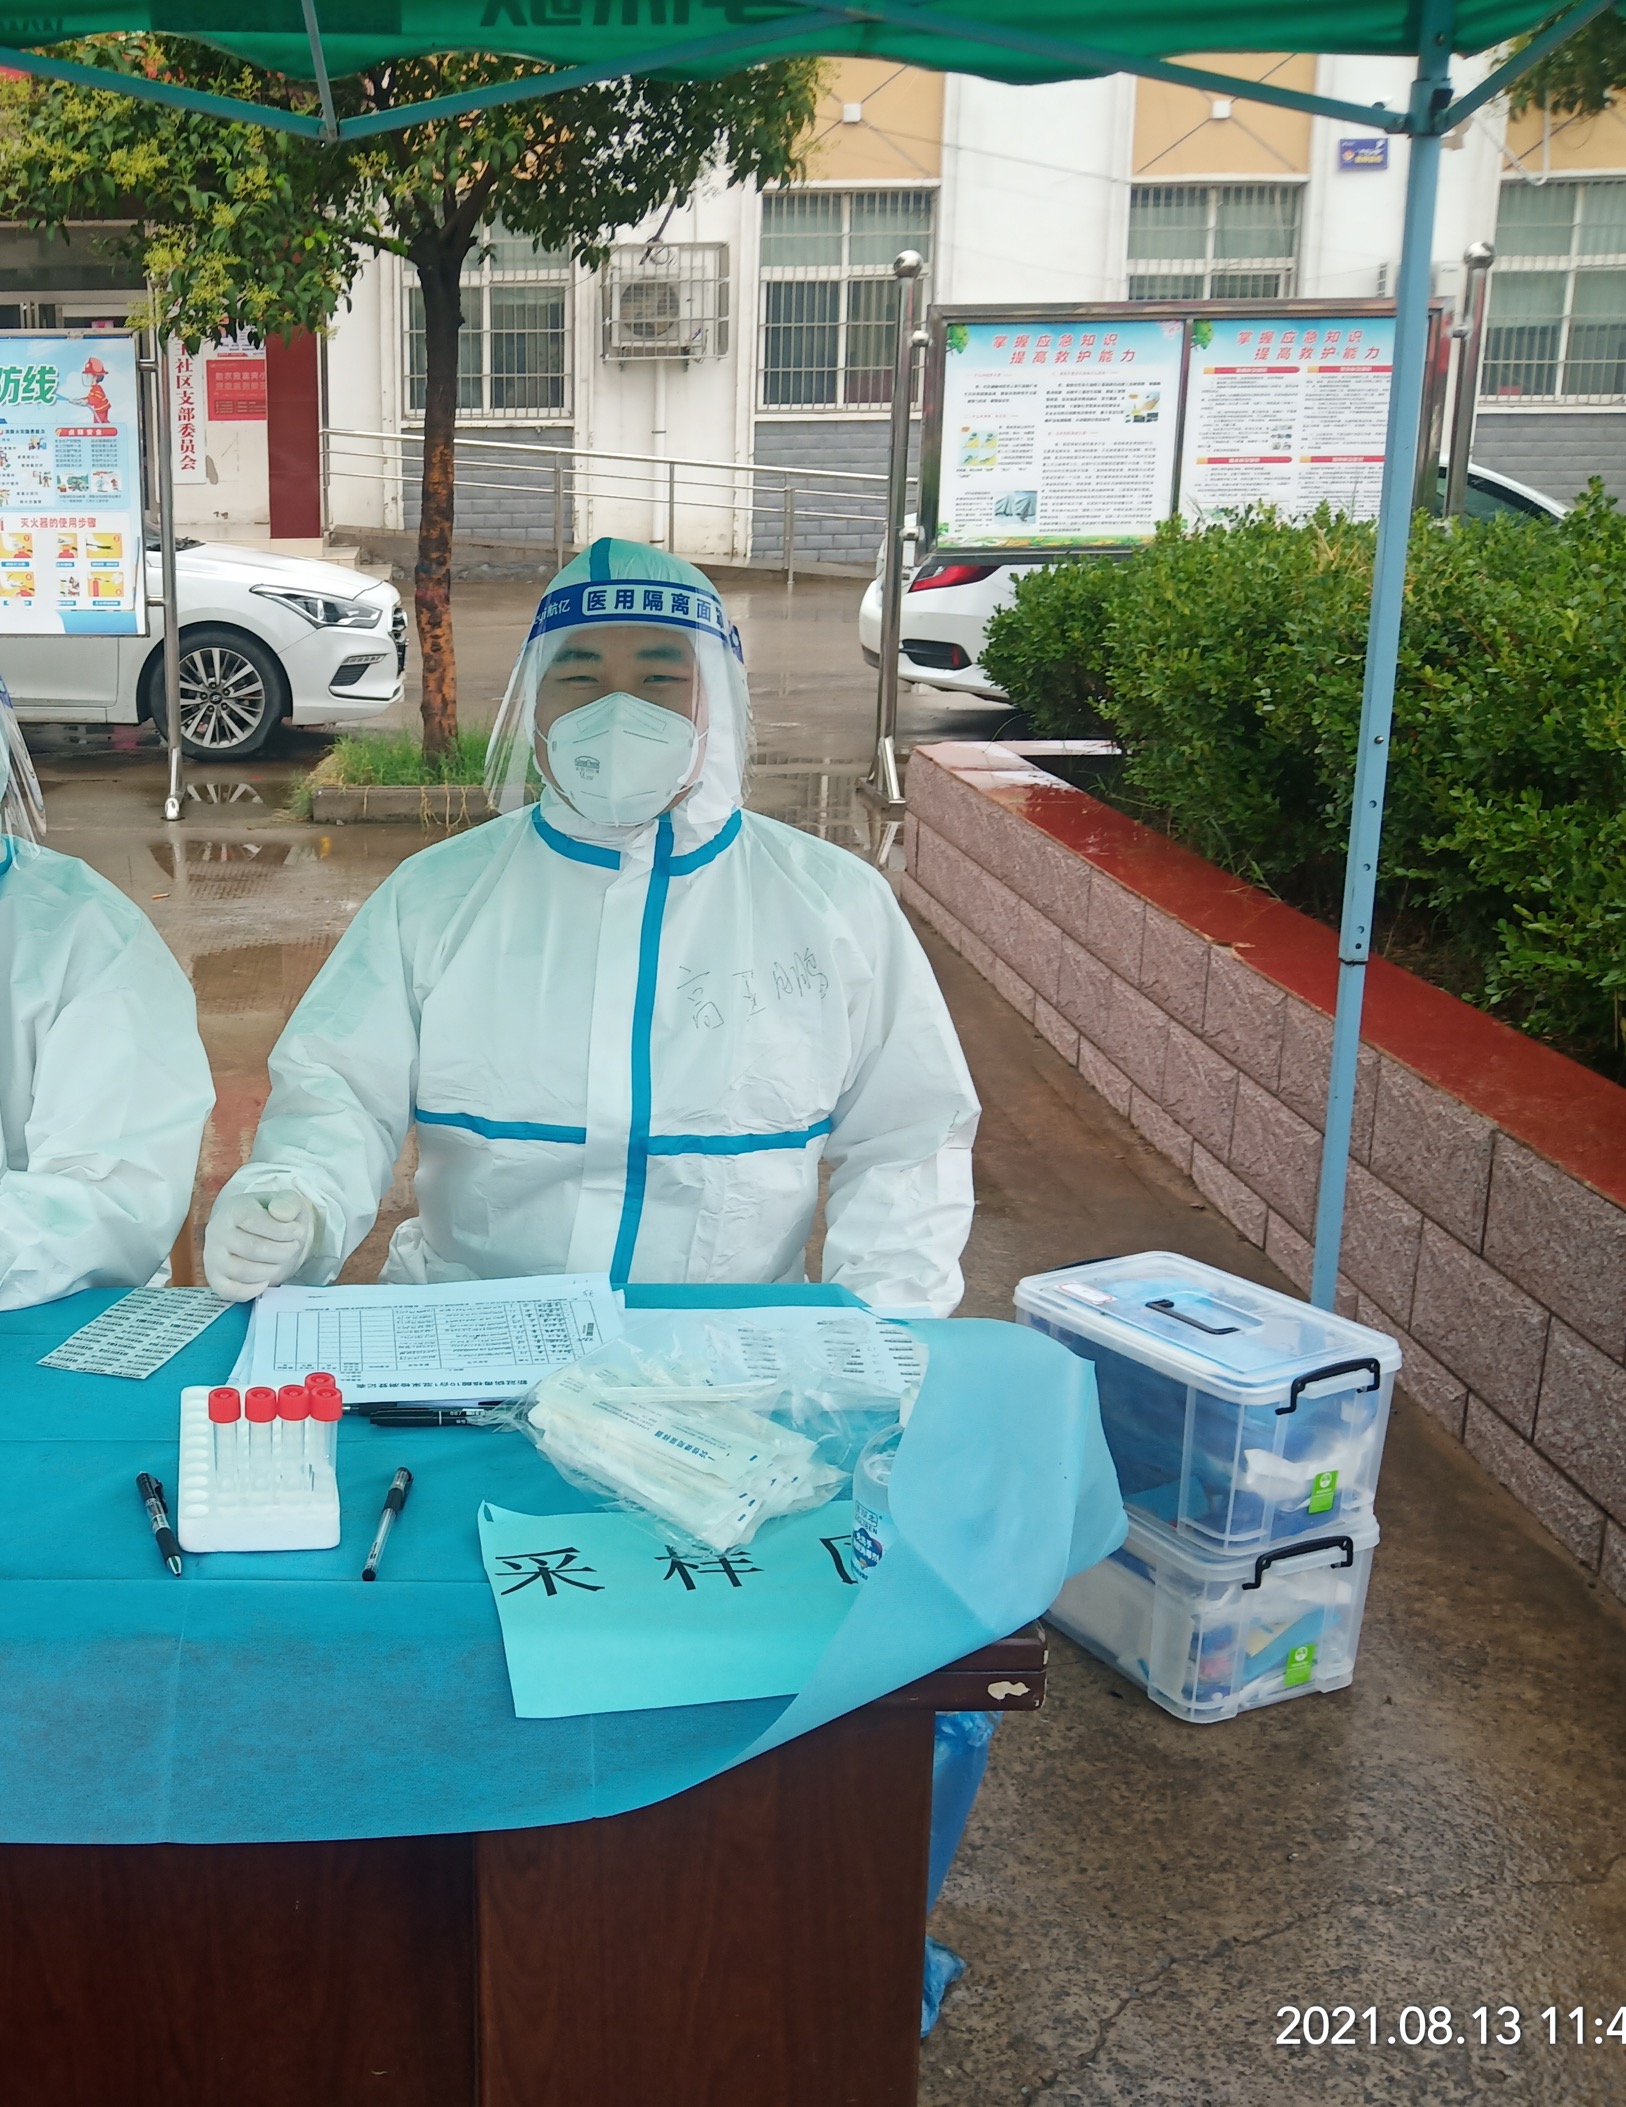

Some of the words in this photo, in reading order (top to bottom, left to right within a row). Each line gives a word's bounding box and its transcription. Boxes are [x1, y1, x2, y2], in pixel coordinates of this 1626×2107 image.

[993, 333, 1118, 349] 掌握应急知识
[1236, 330, 1363, 345] 掌握应急知识
[1009, 349, 1136, 365] 提高救护能力
[1253, 346, 1381, 361] 提高救护能力
[20, 517, 97, 529] 灭火器的使用步骤
